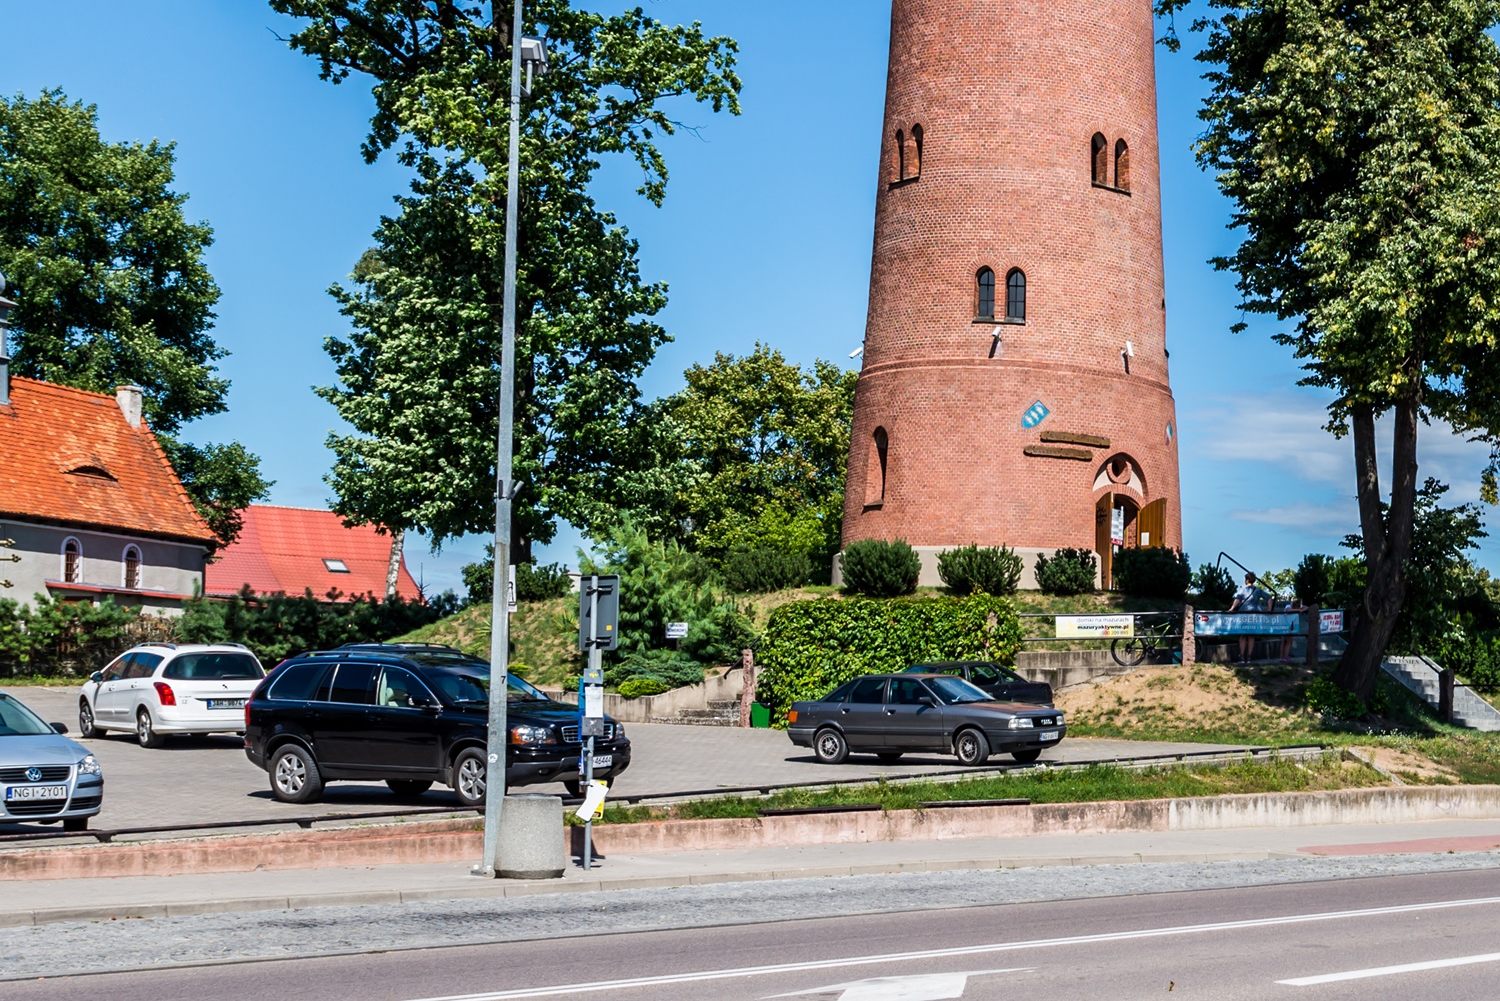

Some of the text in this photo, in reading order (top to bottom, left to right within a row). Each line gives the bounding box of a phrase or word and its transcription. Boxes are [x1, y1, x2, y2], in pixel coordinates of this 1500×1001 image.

[500, 675, 506, 684] 7
[14, 786, 64, 798] NGI 2Y01
